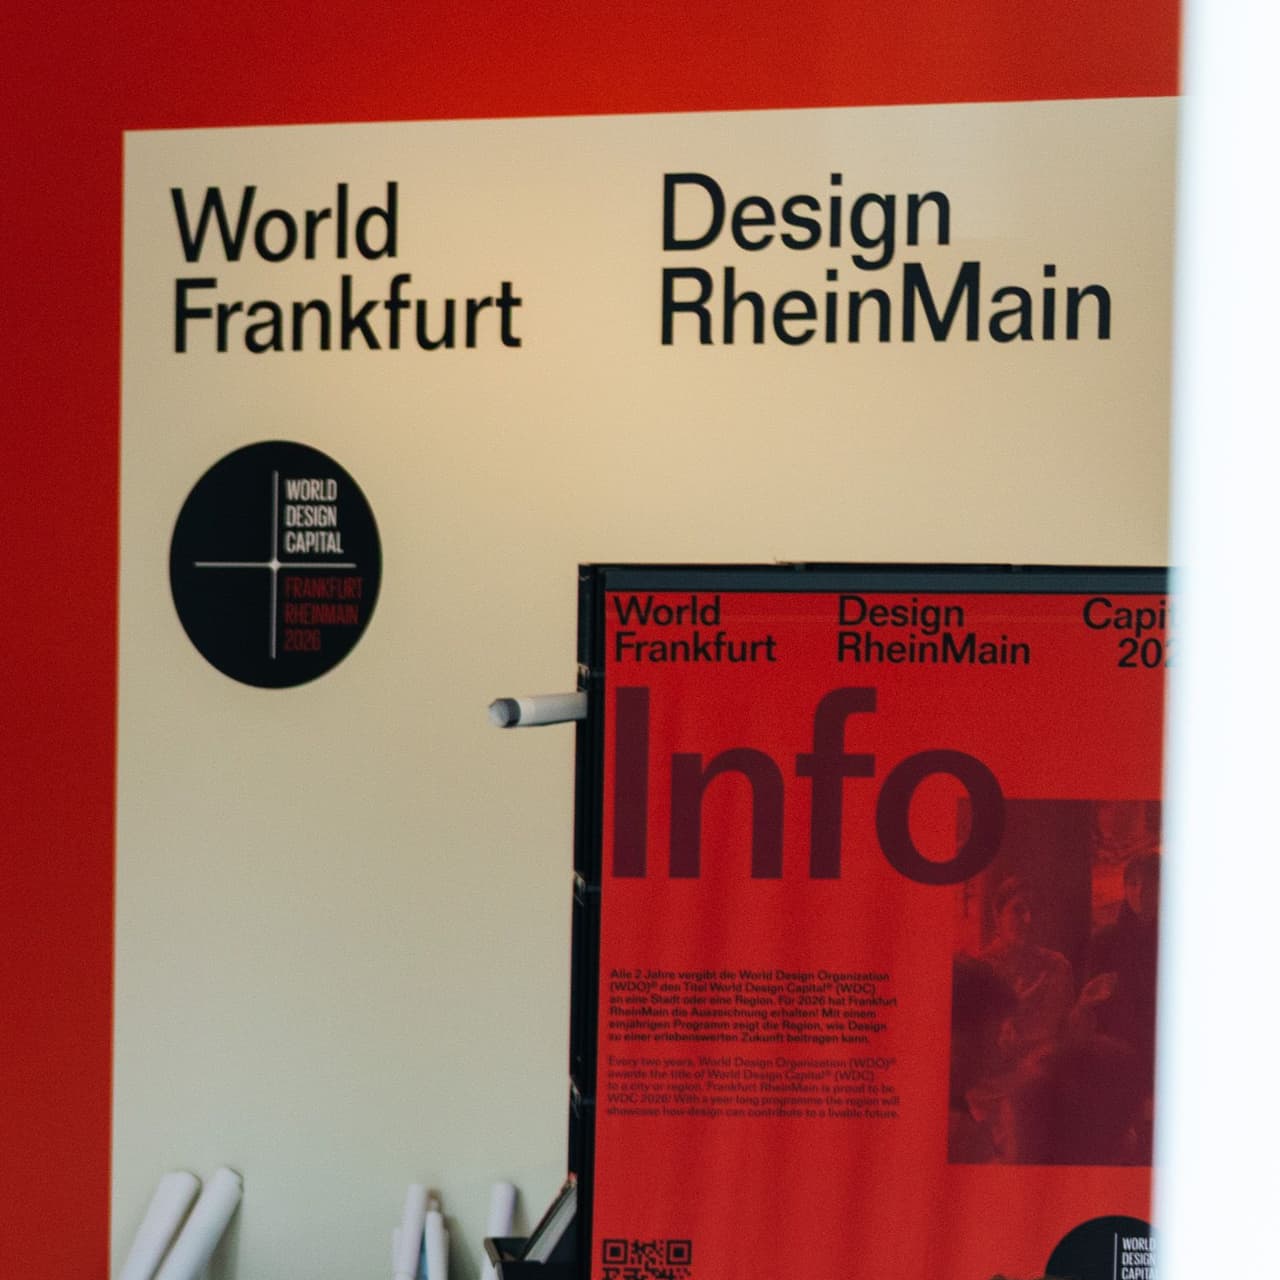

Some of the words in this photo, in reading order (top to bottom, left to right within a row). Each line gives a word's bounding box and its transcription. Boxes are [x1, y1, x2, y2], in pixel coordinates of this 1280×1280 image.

[171, 182, 397, 263] World
[663, 173, 949, 270] Design
[175, 274, 522, 354] Frankfurt
[662, 261, 1112, 345] RheinMain
[285, 479, 337, 501] WORLD
[285, 505, 337, 527] DESIGN
[285, 531, 344, 553] CAPITAL
[285, 577, 362, 599] FRANKFURT
[285, 603, 359, 624] RHEINMAIN
[613, 595, 721, 626] World
[838, 595, 964, 635] Design
[1083, 598, 1171, 638] Capi
[285, 629, 320, 651] 2026
[615, 631, 777, 663] Frankfurt
[837, 631, 1030, 665] RheinMain
[612, 686, 1007, 885] Info
[1122, 1267, 1158, 1280] CAPITA
